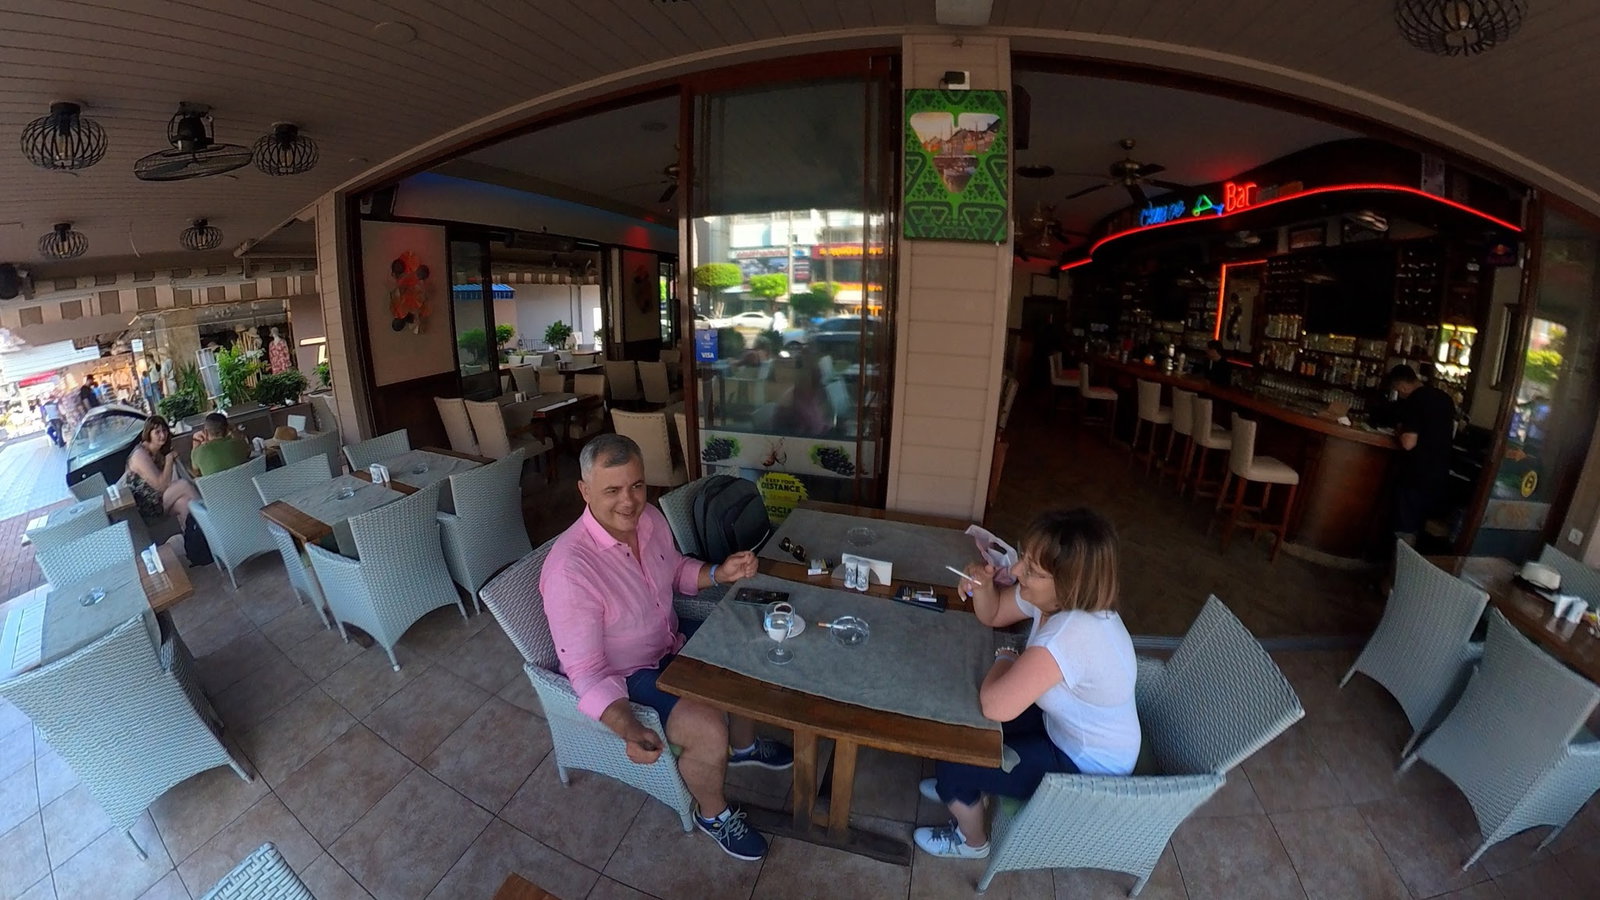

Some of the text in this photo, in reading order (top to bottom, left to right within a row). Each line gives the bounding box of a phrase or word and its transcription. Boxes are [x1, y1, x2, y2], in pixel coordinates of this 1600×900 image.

[1225, 182, 1257, 213] Bar
[761, 482, 801, 492] DISTANCE
[766, 505, 791, 513] SOCIA
